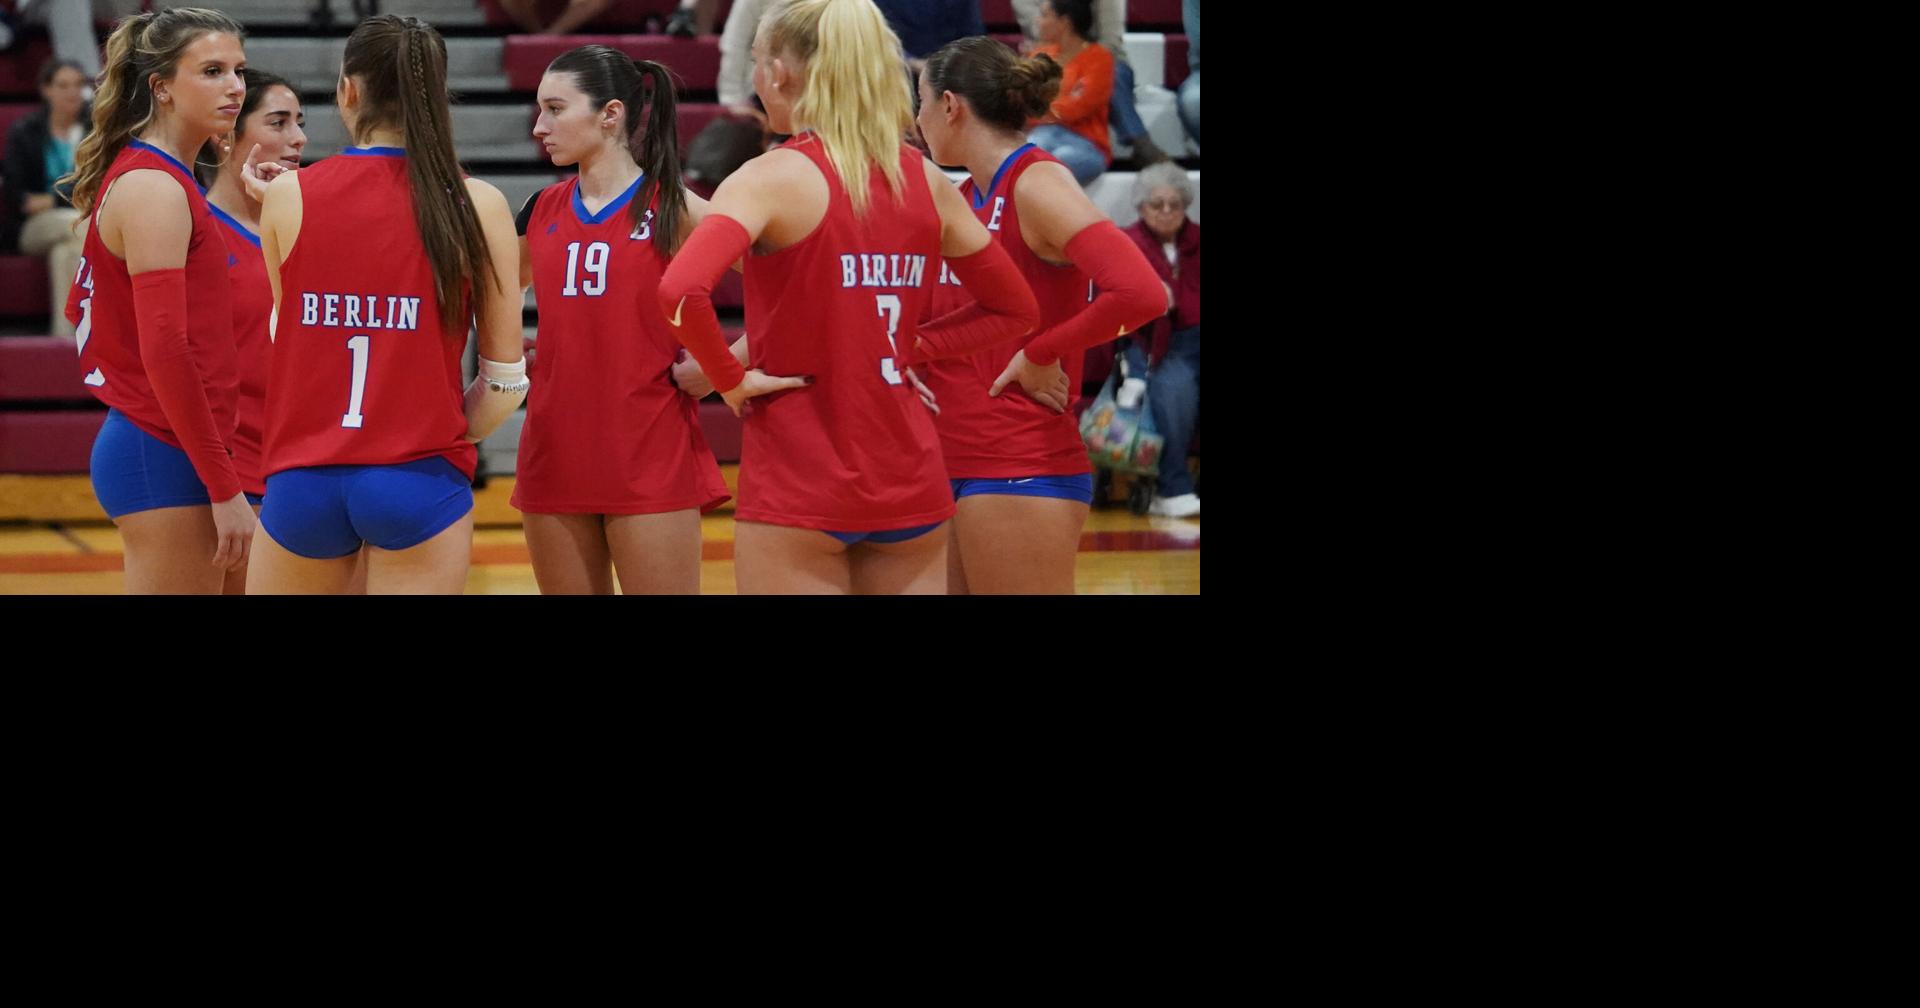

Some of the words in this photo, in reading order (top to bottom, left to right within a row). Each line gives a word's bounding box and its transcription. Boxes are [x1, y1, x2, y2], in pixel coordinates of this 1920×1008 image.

[562, 241, 610, 297] 19
[840, 253, 926, 288] BERLIN
[301, 292, 420, 330] BERLIN
[875, 294, 903, 385] 3
[341, 334, 370, 428] 1
